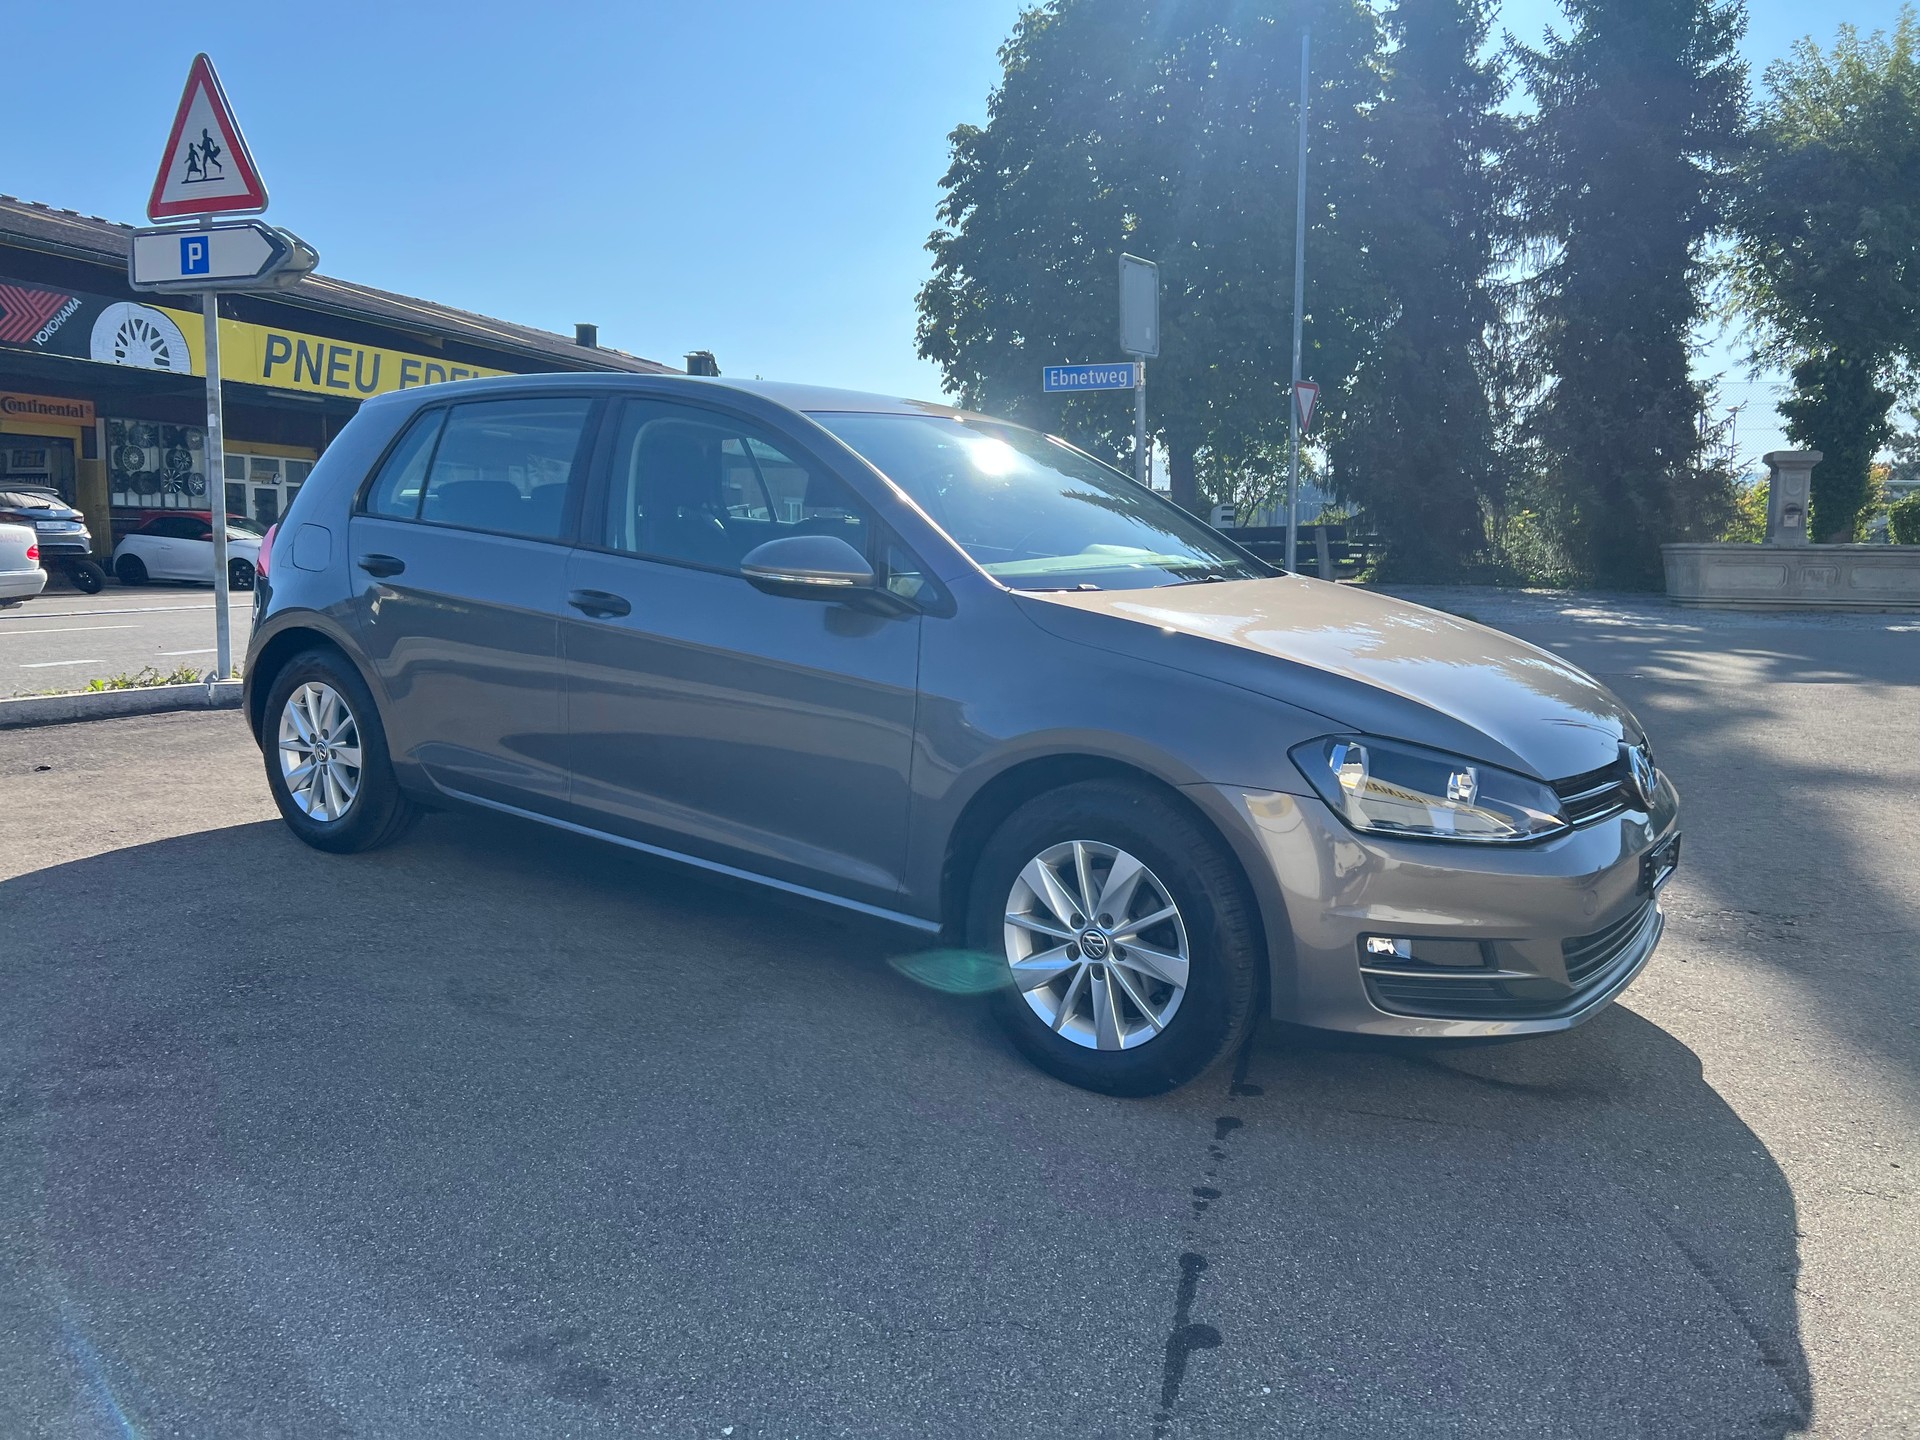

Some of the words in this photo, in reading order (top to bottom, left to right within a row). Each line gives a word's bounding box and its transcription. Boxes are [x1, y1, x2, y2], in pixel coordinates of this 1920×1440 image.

[187, 242, 202, 270] P
[32, 297, 82, 346] YOKOHAMA
[263, 333, 381, 393] PNEU
[399, 358, 479, 390] ED
[1050, 369, 1128, 388] Ebnetweg
[1, 396, 84, 418] Continental
